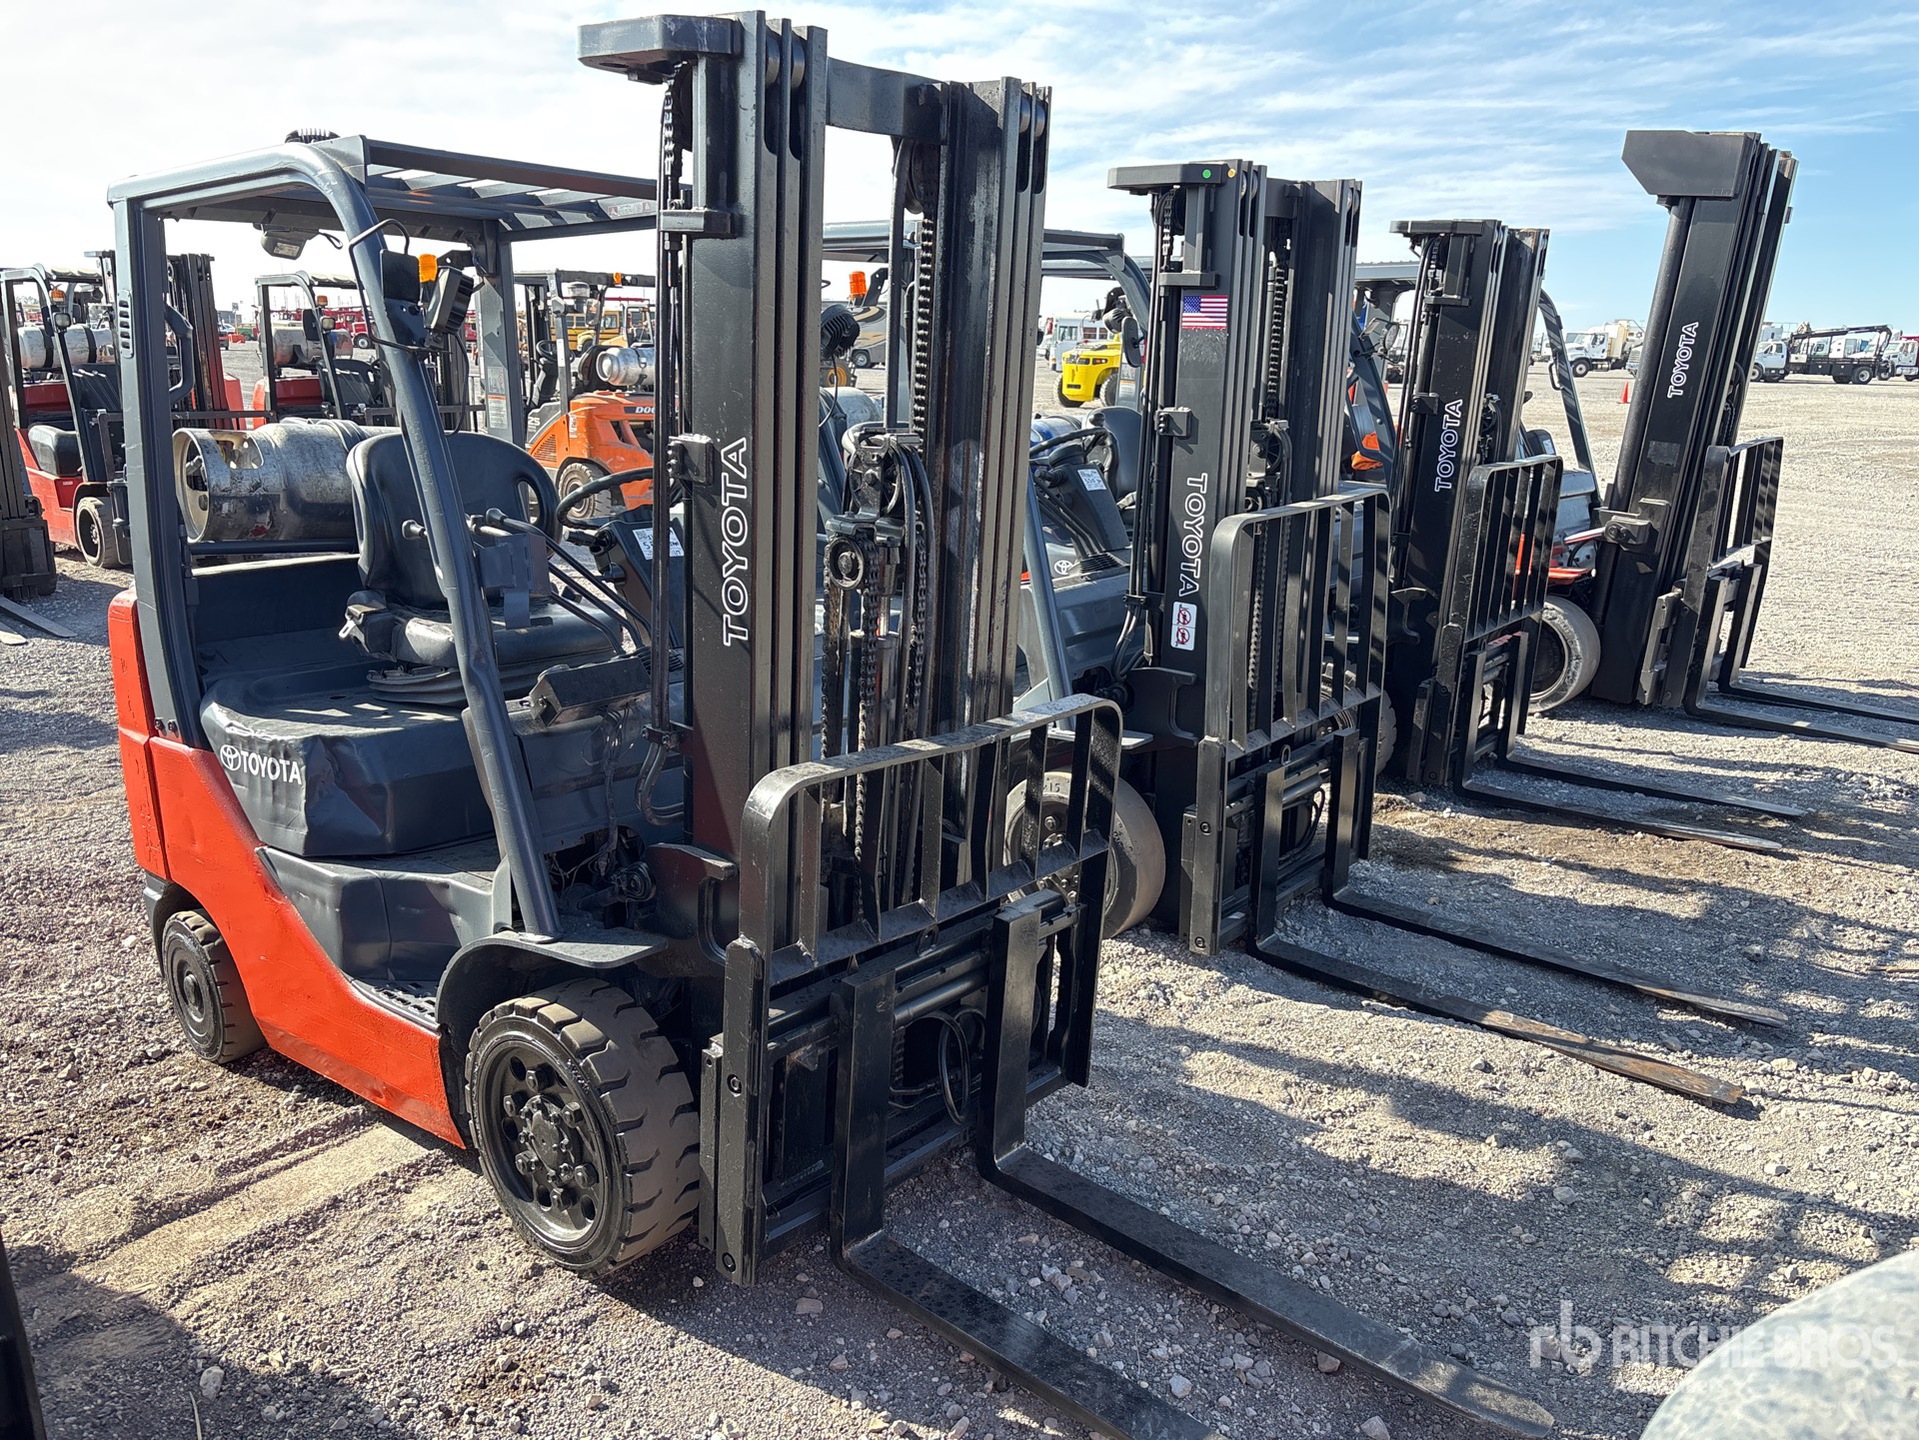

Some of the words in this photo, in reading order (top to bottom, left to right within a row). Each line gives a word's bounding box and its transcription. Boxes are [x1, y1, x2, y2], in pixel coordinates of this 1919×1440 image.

[1667, 321, 1699, 399] TOYOTA
[1434, 399, 1463, 492] TOYOTA
[721, 436, 749, 647] TOYOTA
[1179, 472, 1208, 597] TOYOTA
[240, 749, 302, 785] TOYOTA
